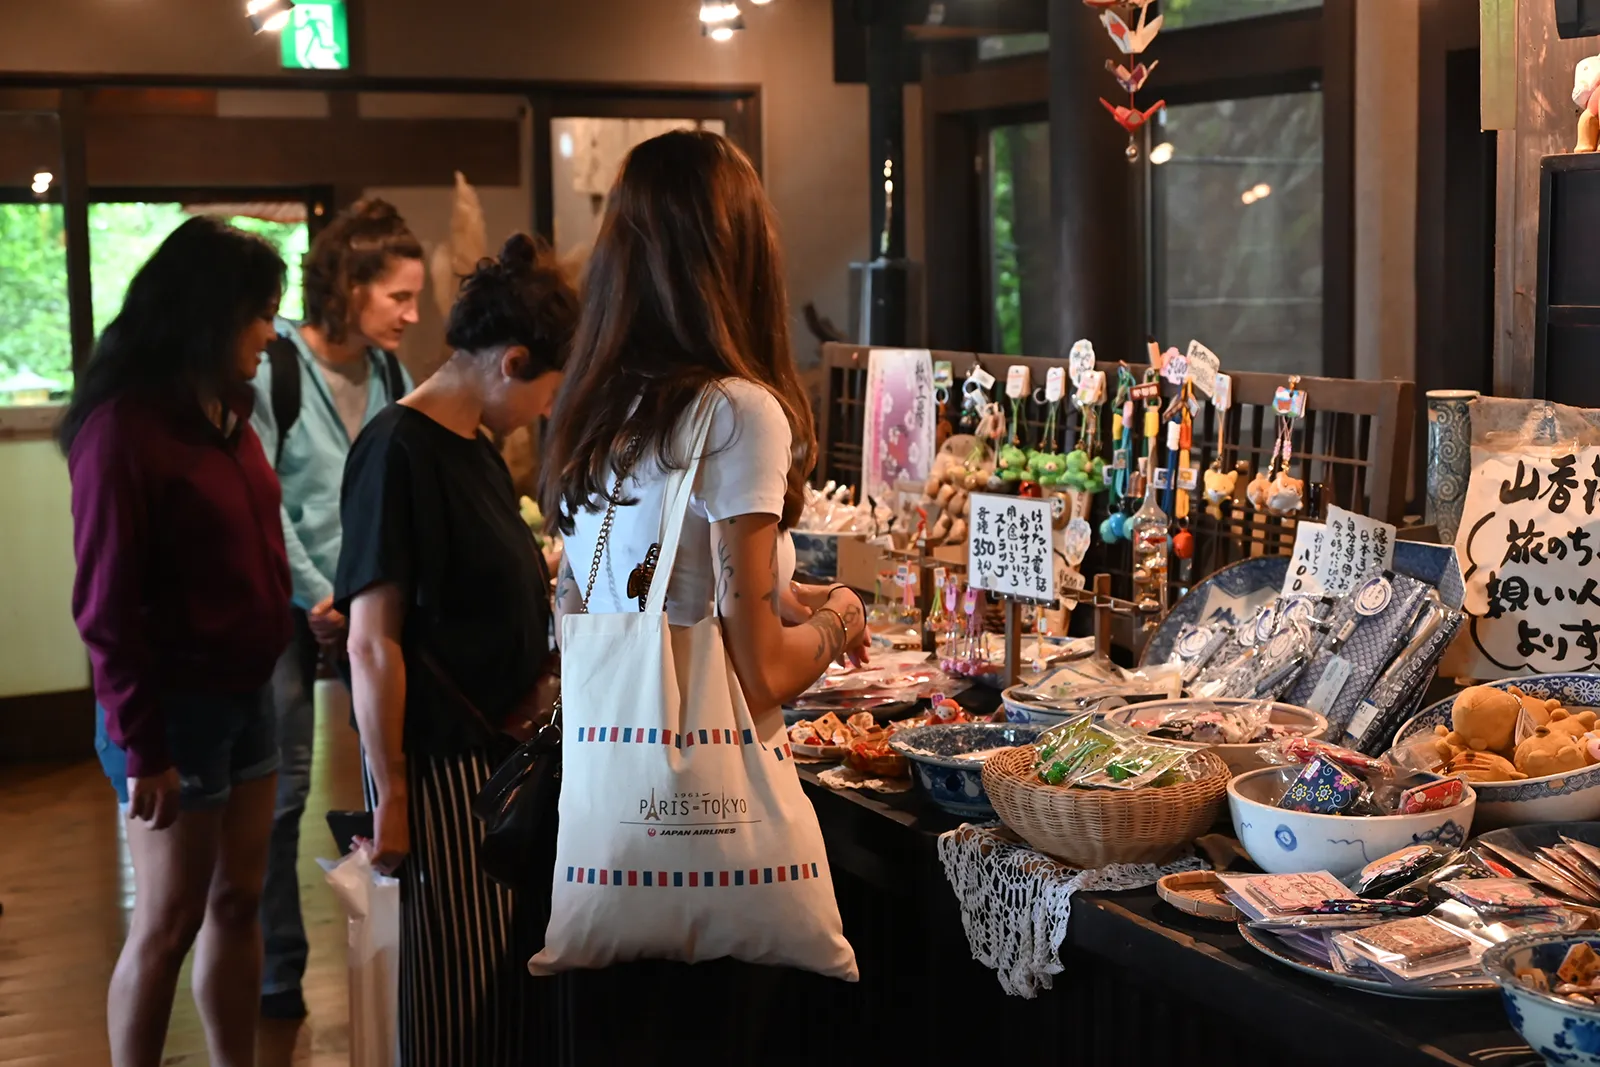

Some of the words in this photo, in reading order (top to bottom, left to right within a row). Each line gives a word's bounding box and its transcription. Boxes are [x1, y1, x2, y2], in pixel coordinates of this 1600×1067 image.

[1500, 518, 1600, 567] 旅のち
[692, 828, 736, 836] AIRLINES
